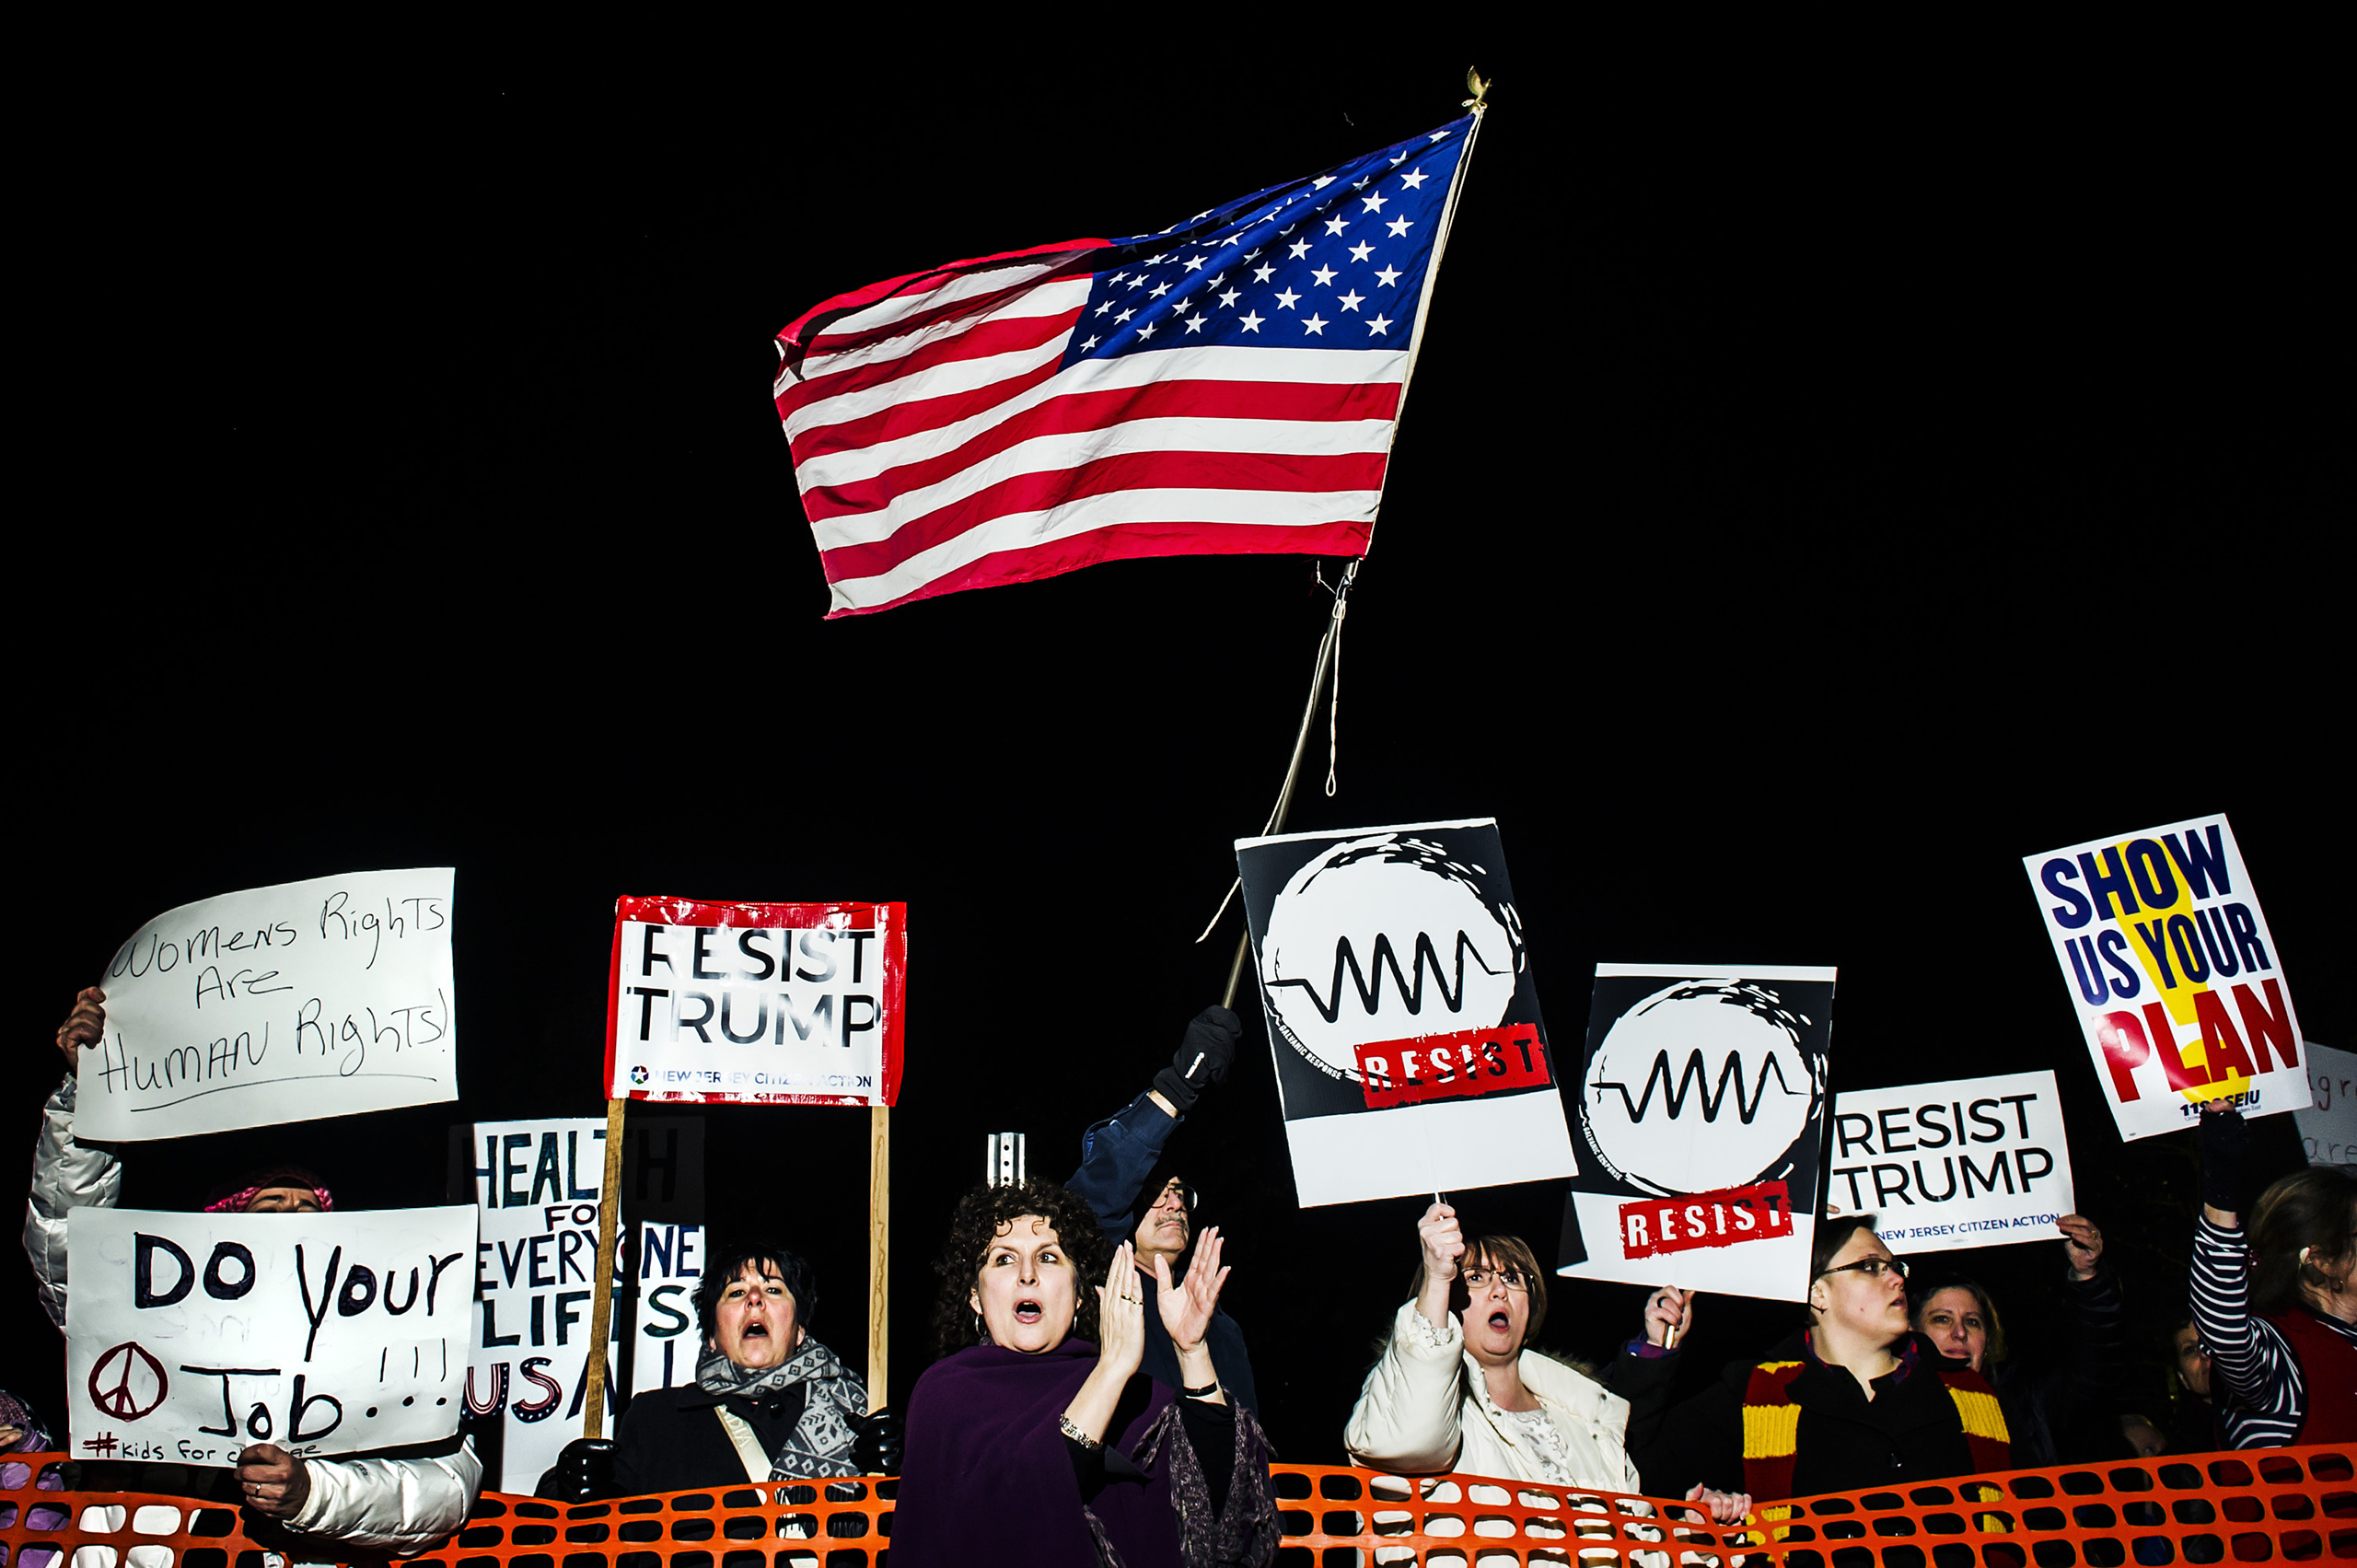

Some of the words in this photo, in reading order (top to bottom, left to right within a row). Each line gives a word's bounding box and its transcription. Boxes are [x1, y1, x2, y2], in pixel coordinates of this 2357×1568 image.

[2040, 824, 2232, 930] SHOW
[642, 923, 877, 984] RESIST
[2063, 929, 2141, 1006] US
[2133, 902, 2272, 990] YOUR
[631, 987, 882, 1048] TRUMP
[2091, 978, 2300, 1104] PLAN
[655, 1070, 692, 1083] NEW
[816, 1074, 873, 1088] ACTION
[1278, 1024, 1308, 1056] GALVANIC
[1305, 1052, 1343, 1081] RESPONSE
[1364, 1039, 1536, 1093] RESIST
[1834, 1093, 2038, 1158] RESIST
[1832, 1147, 2054, 1211] TRUMP
[544, 1202, 604, 1233] FO
[1626, 1194, 1783, 1248] RESIST
[1875, 1229, 1907, 1241] NEW
[1910, 1225, 1956, 1238] JERSEY
[1958, 1219, 2009, 1233] CITIZEN
[2012, 1213, 2061, 1227] ACTION
